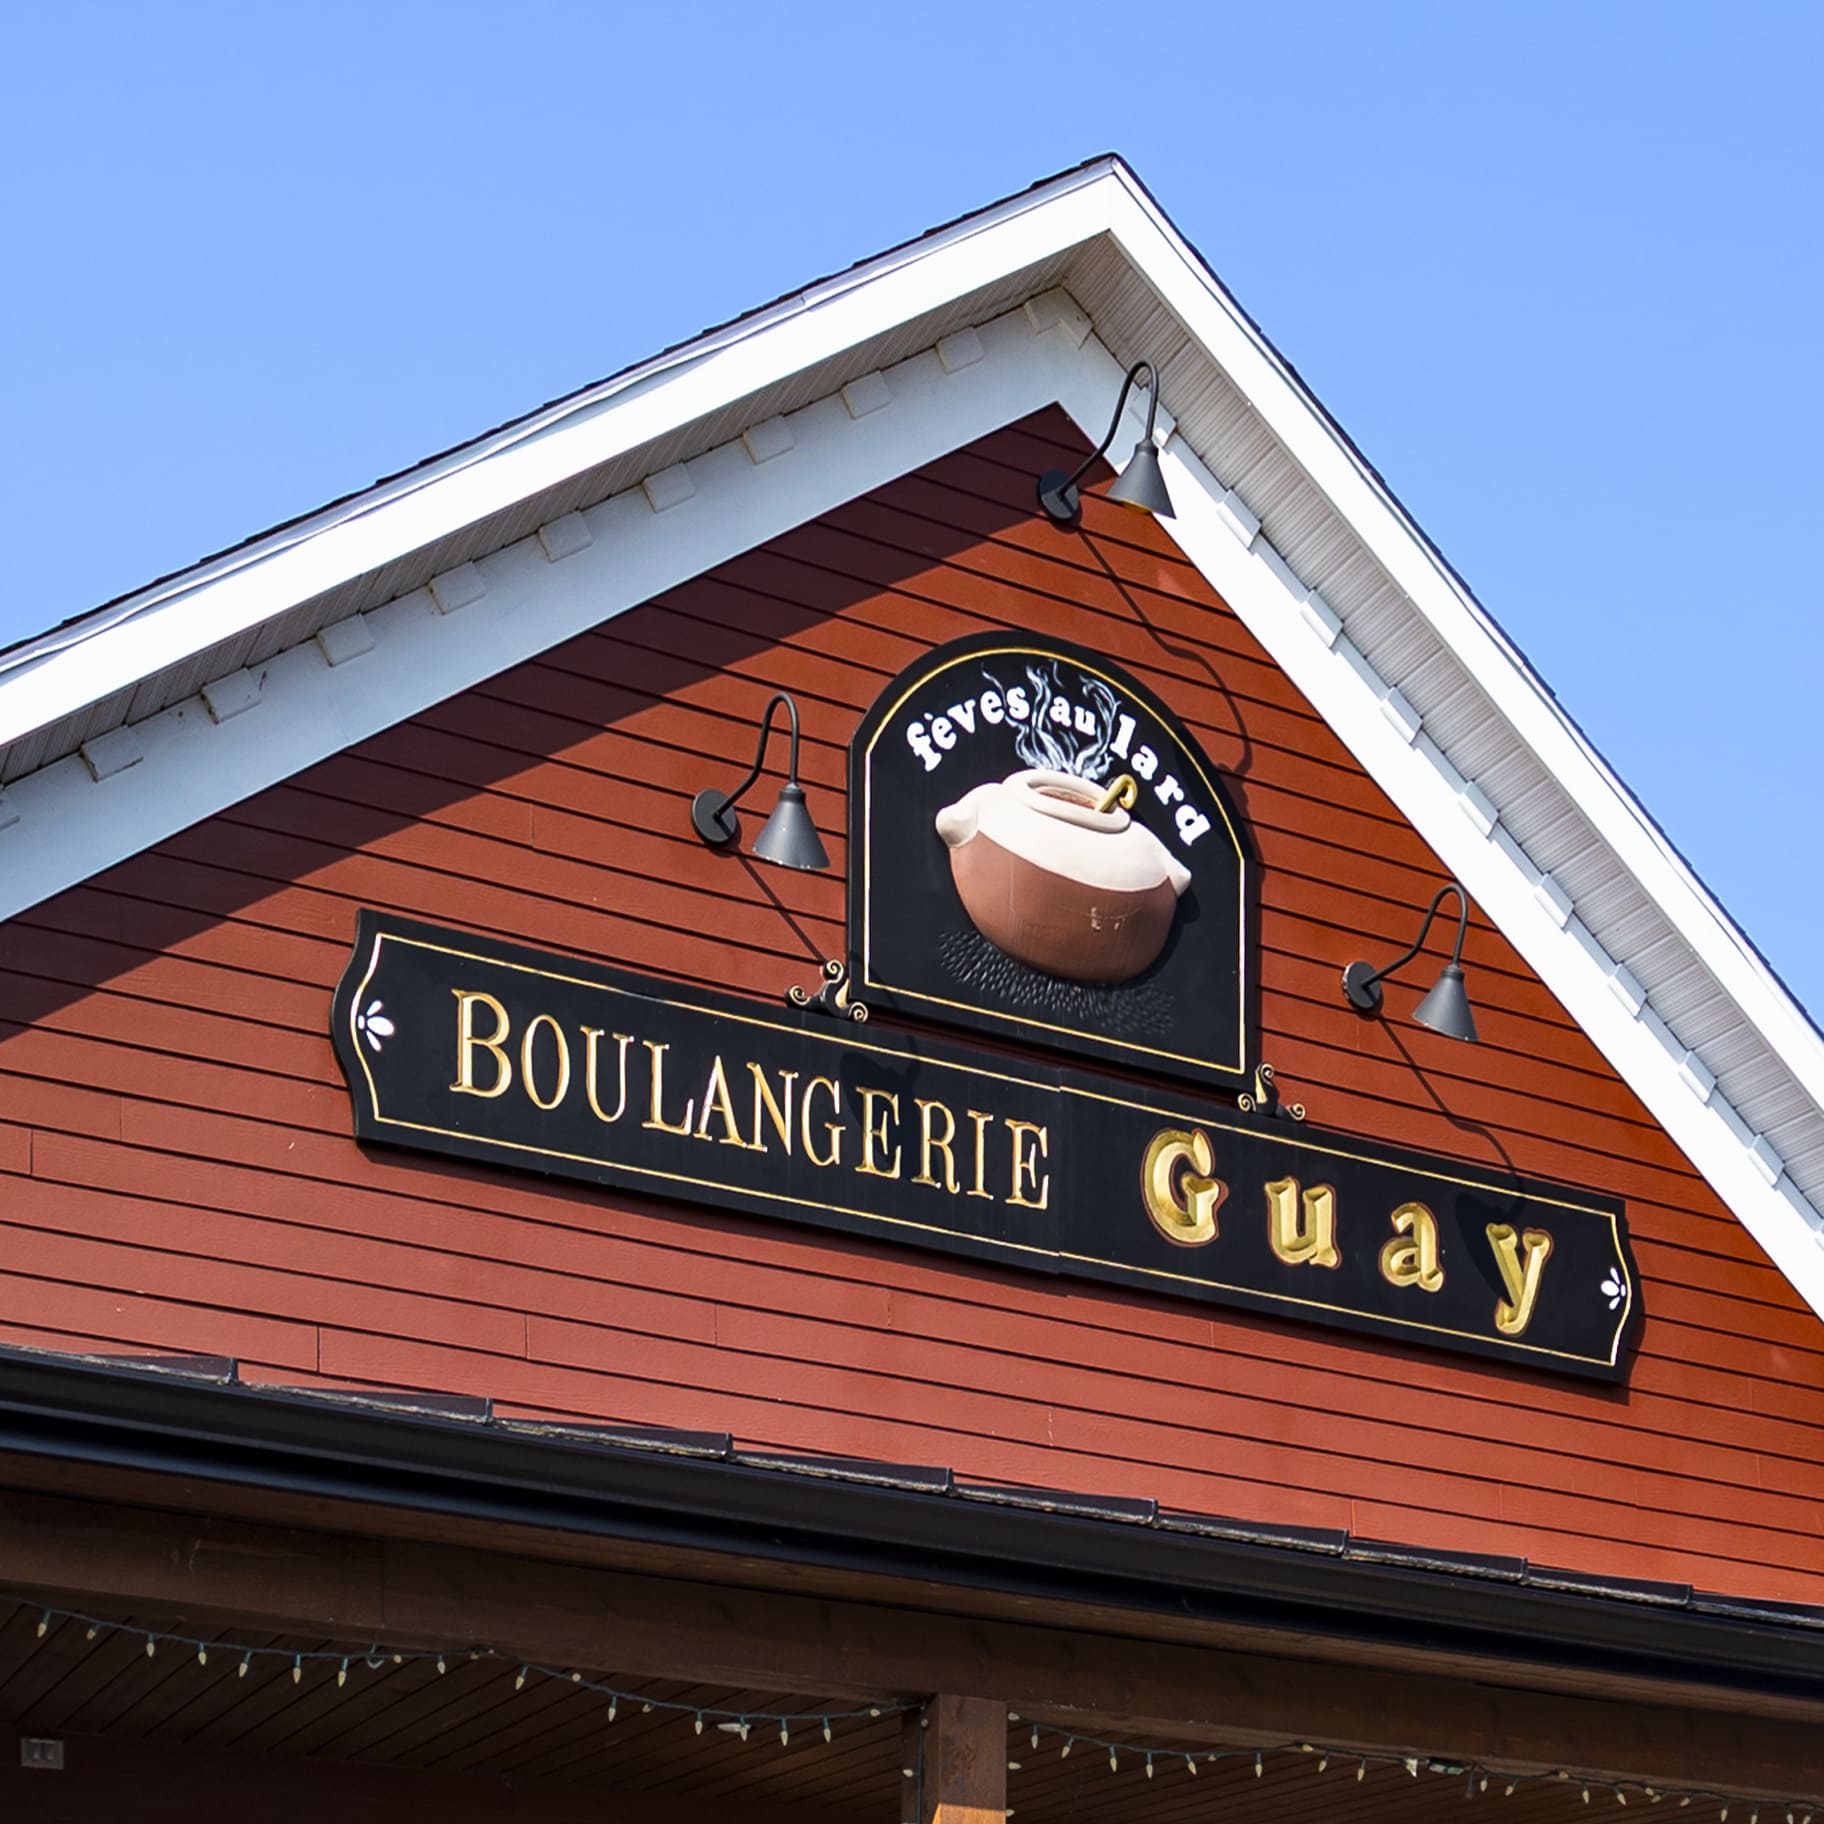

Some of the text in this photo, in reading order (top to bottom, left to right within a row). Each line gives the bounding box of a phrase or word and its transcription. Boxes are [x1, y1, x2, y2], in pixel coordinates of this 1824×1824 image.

[906, 685, 1212, 847] fèves au lard
[451, 987, 1555, 1337] BOULANGERIE Guay
